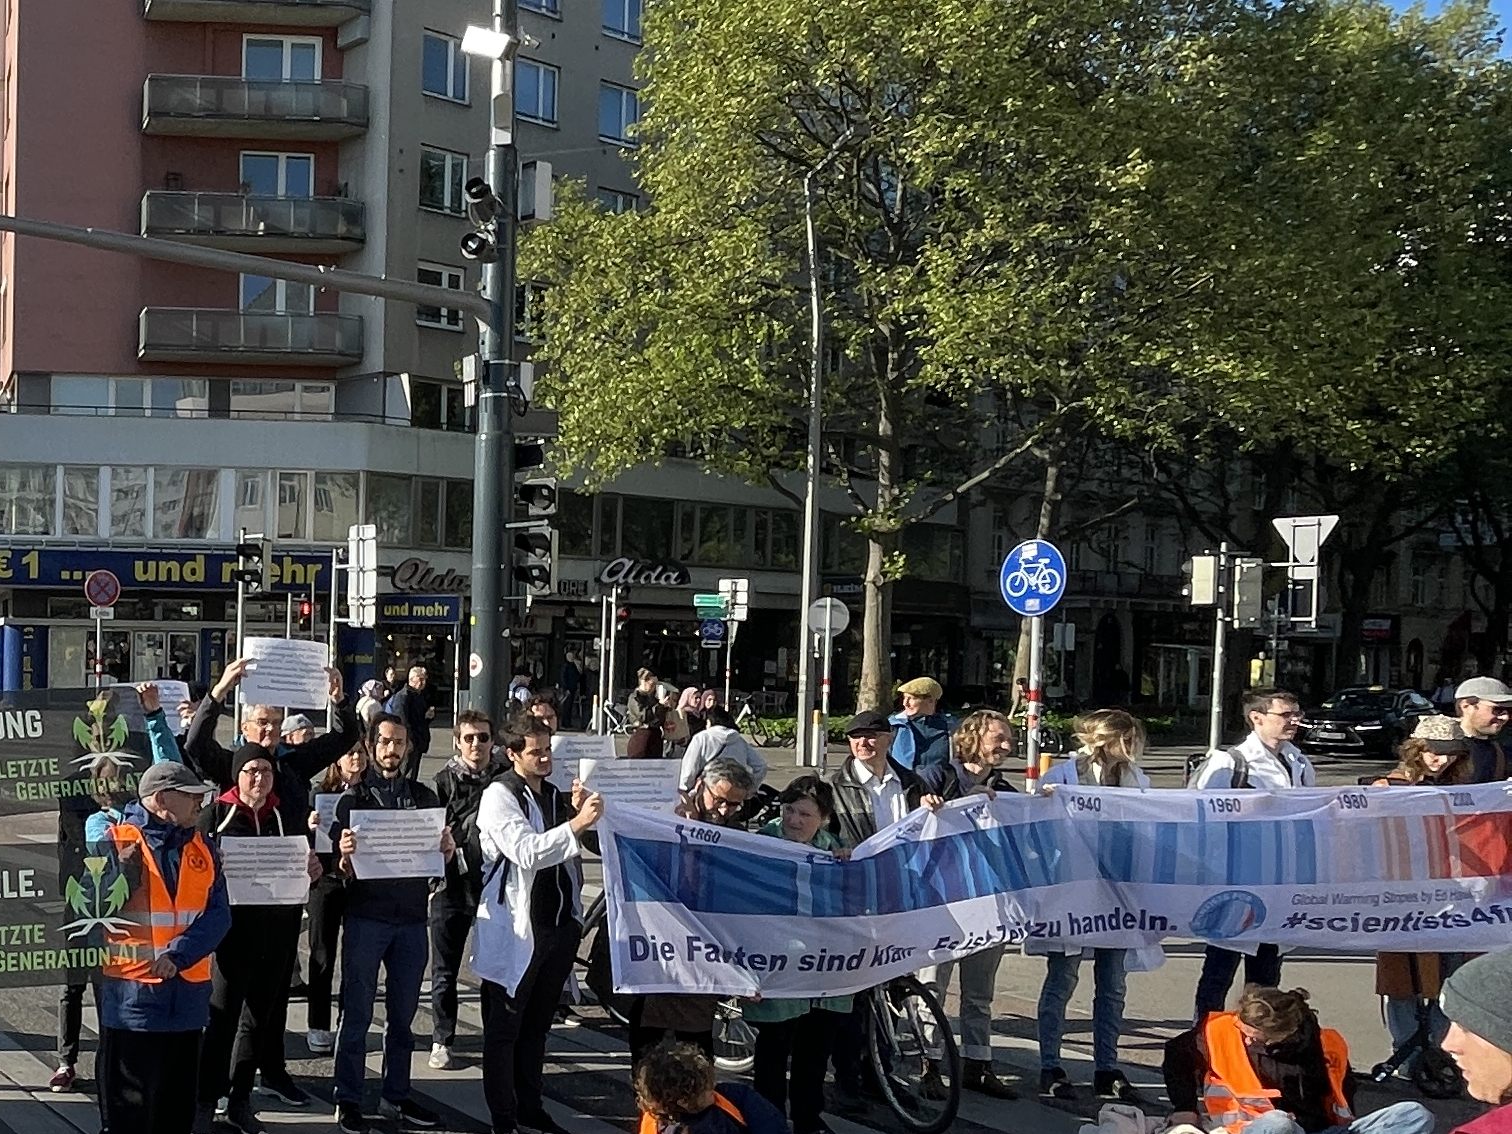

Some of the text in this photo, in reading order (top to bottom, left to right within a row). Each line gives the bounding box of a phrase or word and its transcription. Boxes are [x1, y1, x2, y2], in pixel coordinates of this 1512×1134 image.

[21, 550, 40, 580] 1
[134, 554, 206, 583] und
[383, 602, 450, 617] und mehr
[1071, 796, 1102, 812] 1940
[1209, 797, 1241, 813] 1960
[1337, 793, 1369, 809] 1980
[1291, 892, 1328, 906] Global
[1331, 891, 1380, 907] Warming
[1421, 889, 1433, 904] by
[628, 935, 676, 963] Die
[797, 947, 867, 973] sind
[1032, 919, 1061, 939] zu
[1068, 906, 1178, 936] handeln.
